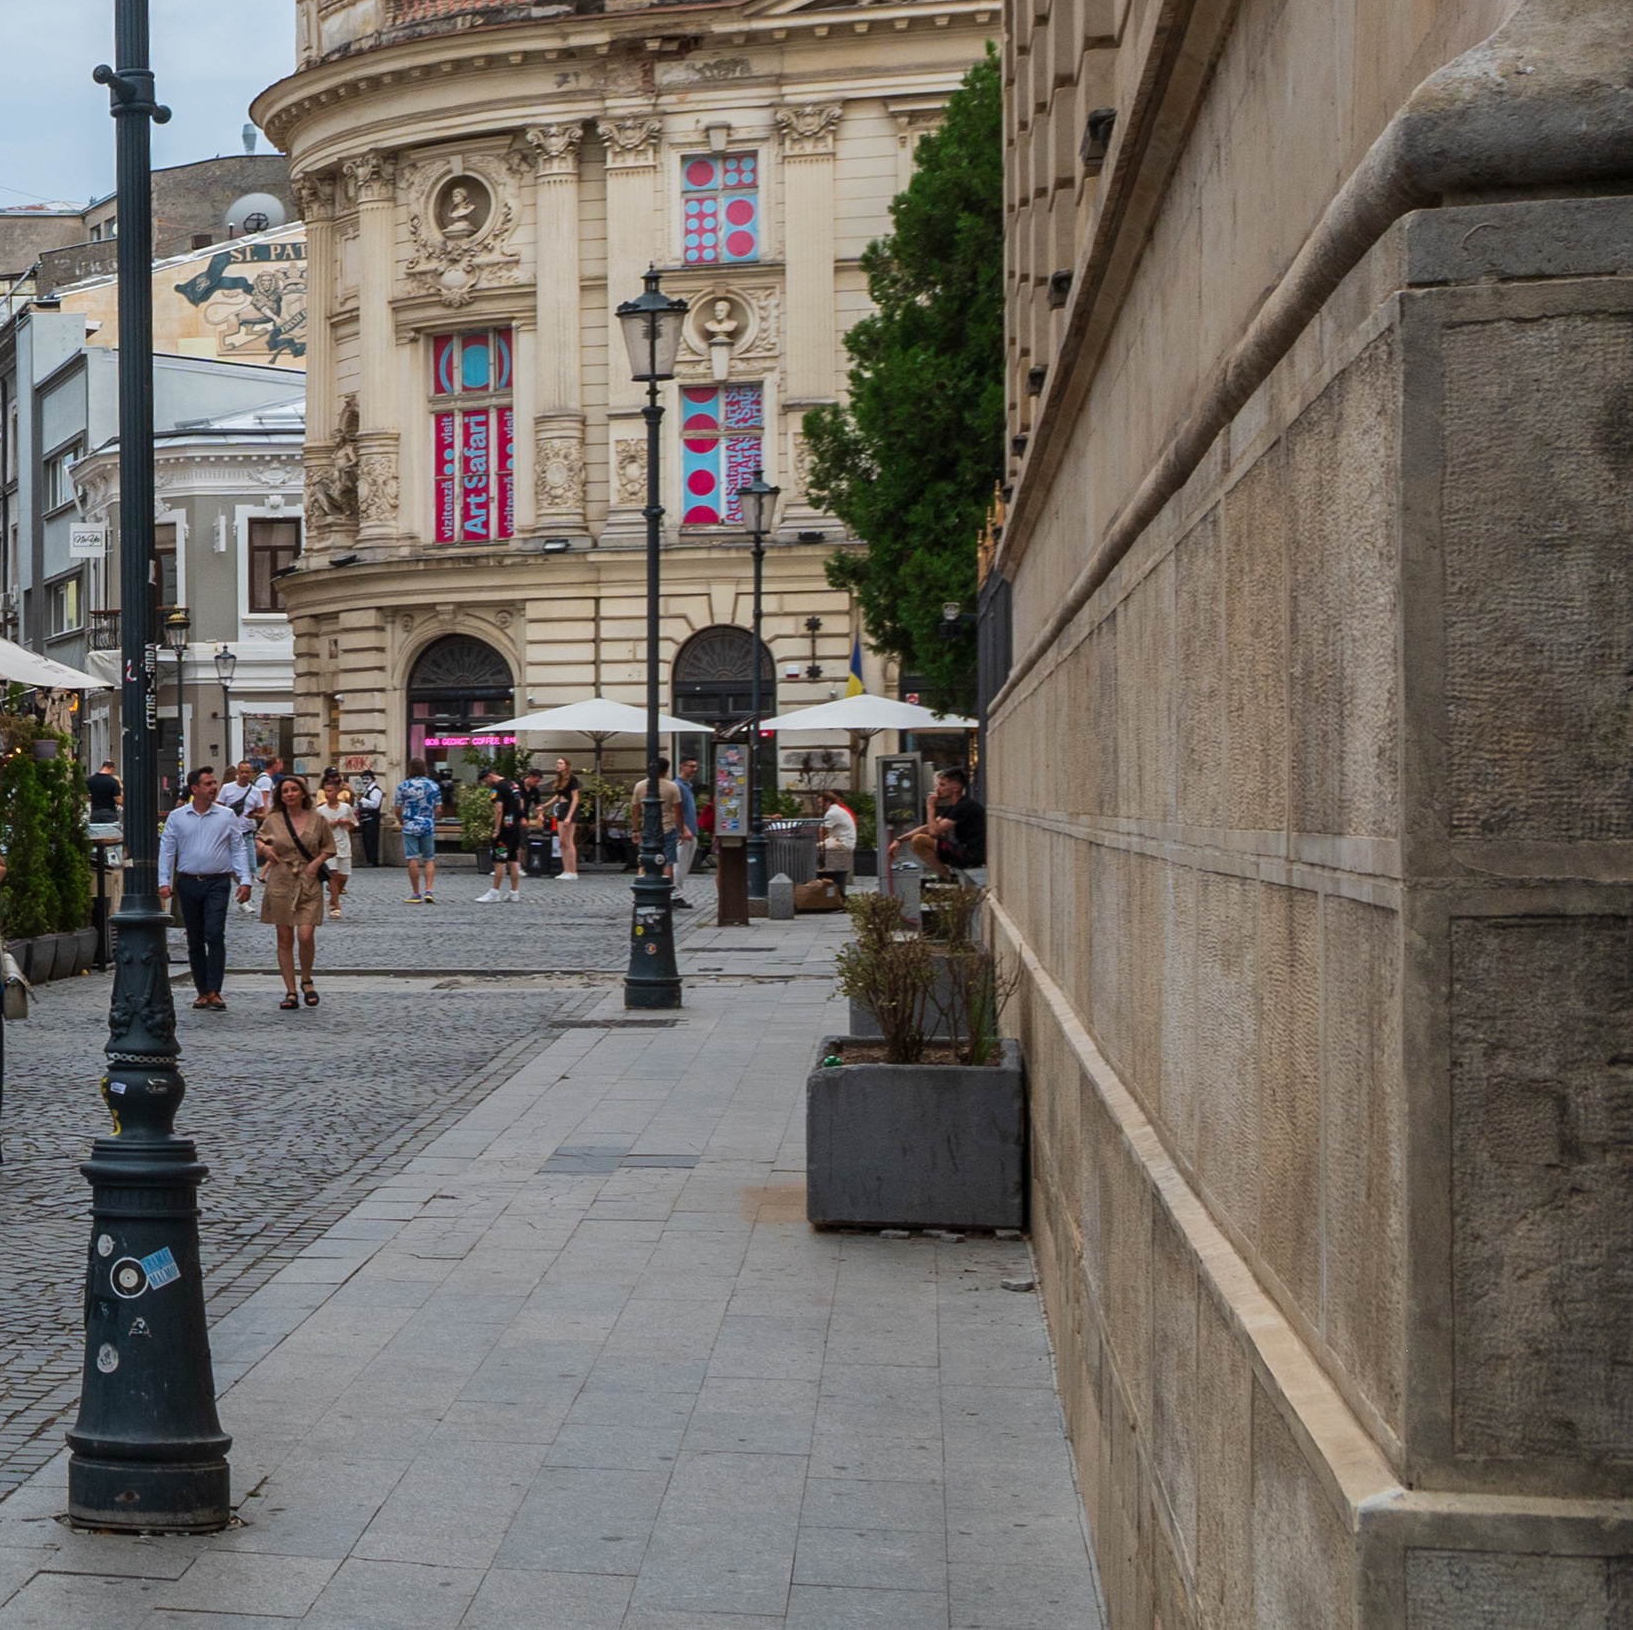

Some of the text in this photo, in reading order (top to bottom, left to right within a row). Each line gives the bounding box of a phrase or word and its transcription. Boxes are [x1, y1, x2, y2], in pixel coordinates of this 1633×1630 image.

[230, 246, 257, 263] ST.
[464, 415, 487, 534] Art Safari
[471, 737, 500, 746] COFFEE
